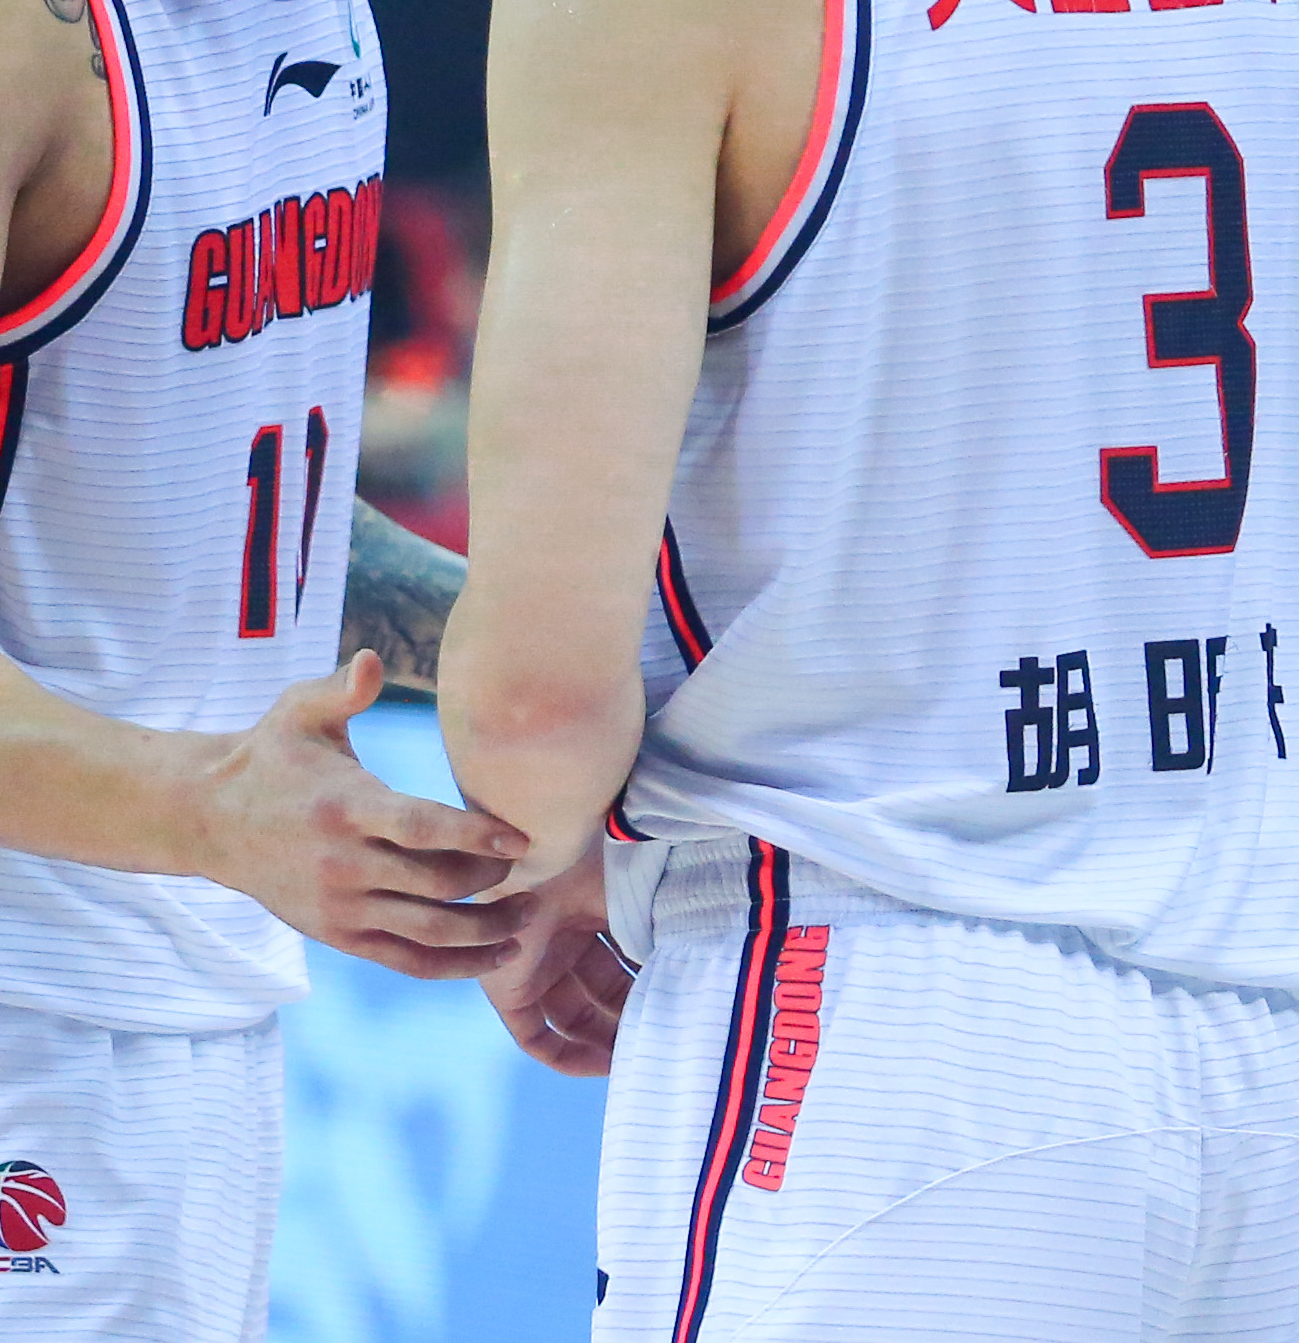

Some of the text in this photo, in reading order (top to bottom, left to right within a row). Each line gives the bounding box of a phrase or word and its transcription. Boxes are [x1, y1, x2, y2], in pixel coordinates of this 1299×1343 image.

[1100, 102, 1256, 558] 3
[999, 622, 1287, 793] 胡明
[742, 924, 830, 1192] GUANGDONG
